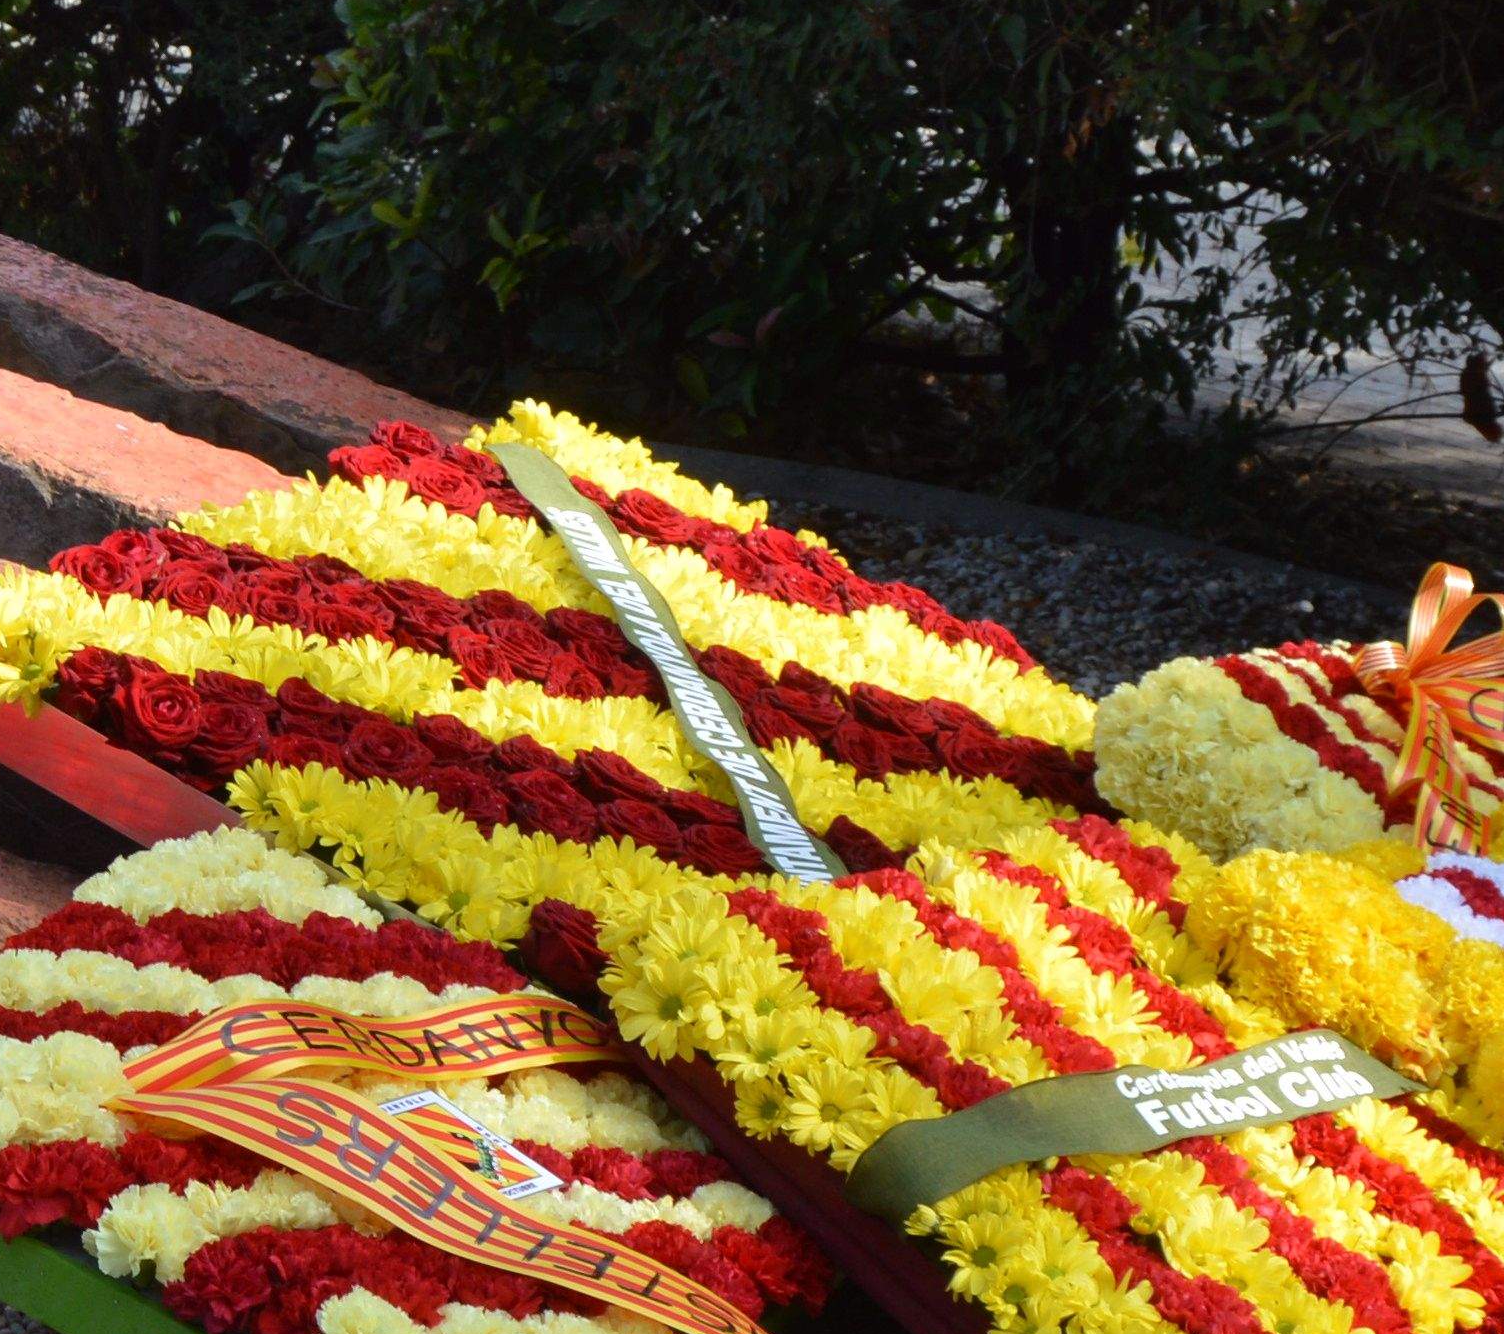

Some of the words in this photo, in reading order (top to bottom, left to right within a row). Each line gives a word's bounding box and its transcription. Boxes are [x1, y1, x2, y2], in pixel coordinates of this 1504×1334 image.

[597, 578, 658, 618] DEL
[625, 613, 745, 747] CERDANYOLA
[709, 747, 769, 782] DE
[1115, 1067, 1244, 1099] Cerdanyola
[1242, 1046, 1286, 1080] del
[1134, 1085, 1283, 1136] Futbol
[1278, 1064, 1375, 1108] Club
